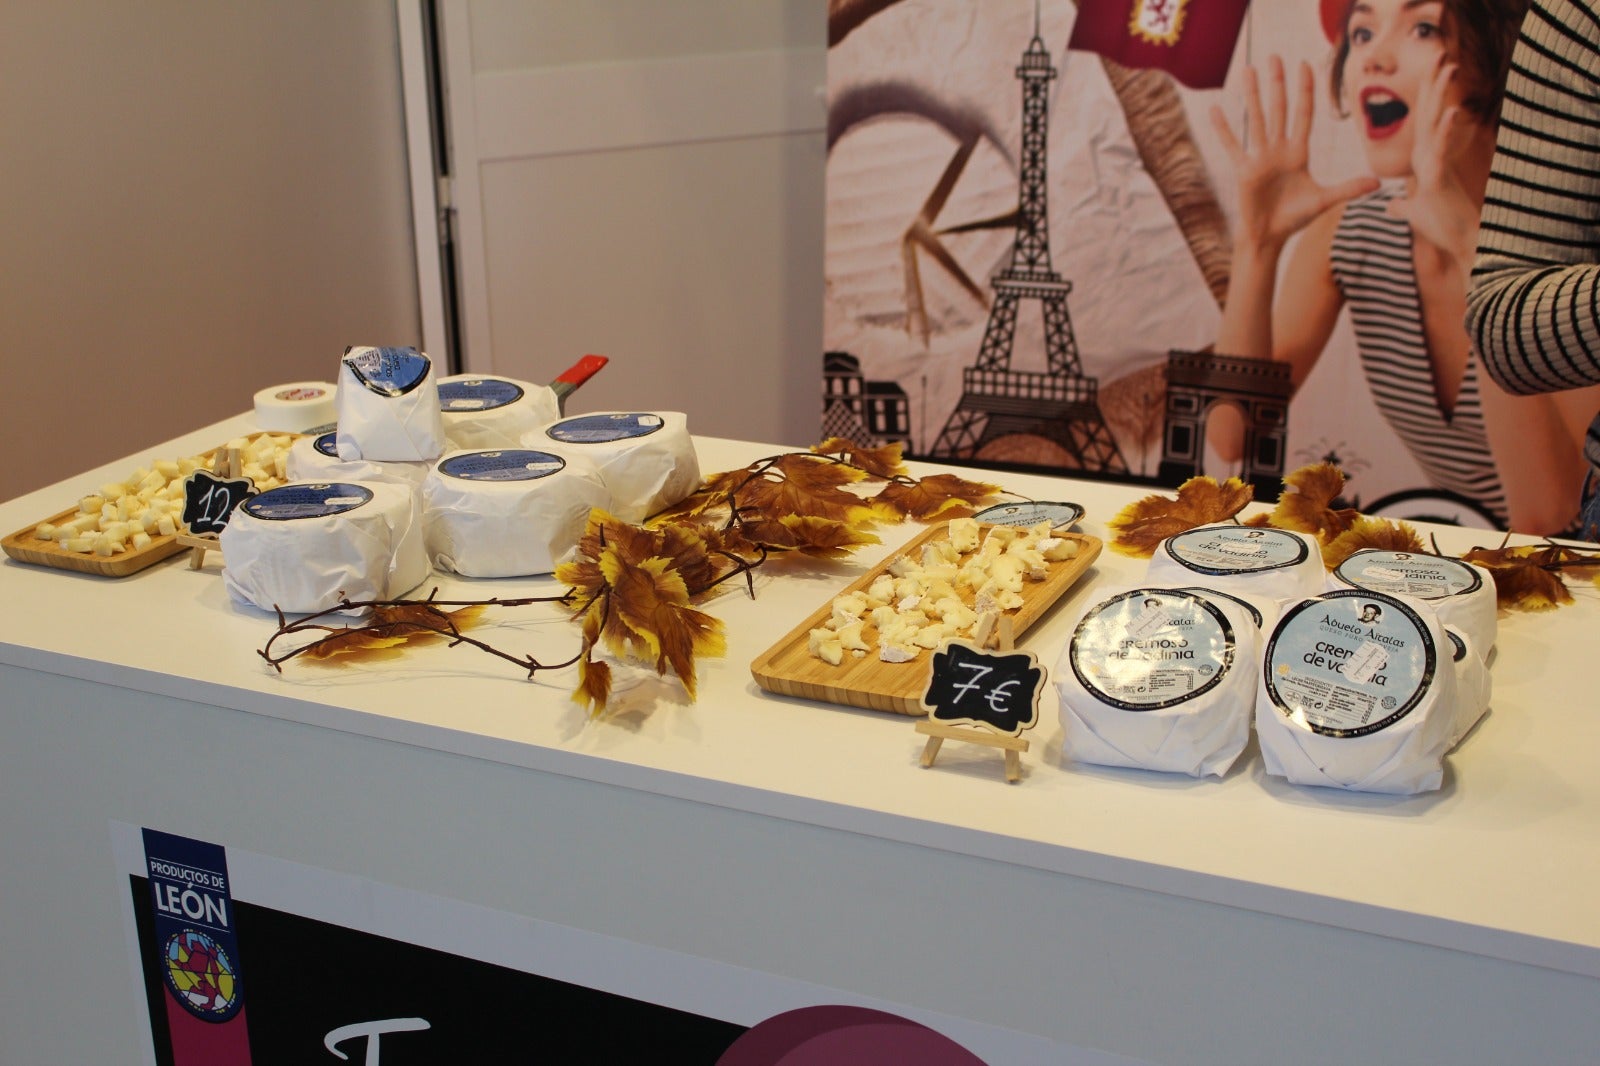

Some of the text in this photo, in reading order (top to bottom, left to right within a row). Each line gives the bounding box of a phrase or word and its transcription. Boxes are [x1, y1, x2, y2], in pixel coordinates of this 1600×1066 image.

[1319, 614, 1362, 635] Abuelo
[1303, 652, 1325, 668] de
[150, 861, 225, 889] PRODUCTOS DE
[154, 881, 228, 927] LEÓN
